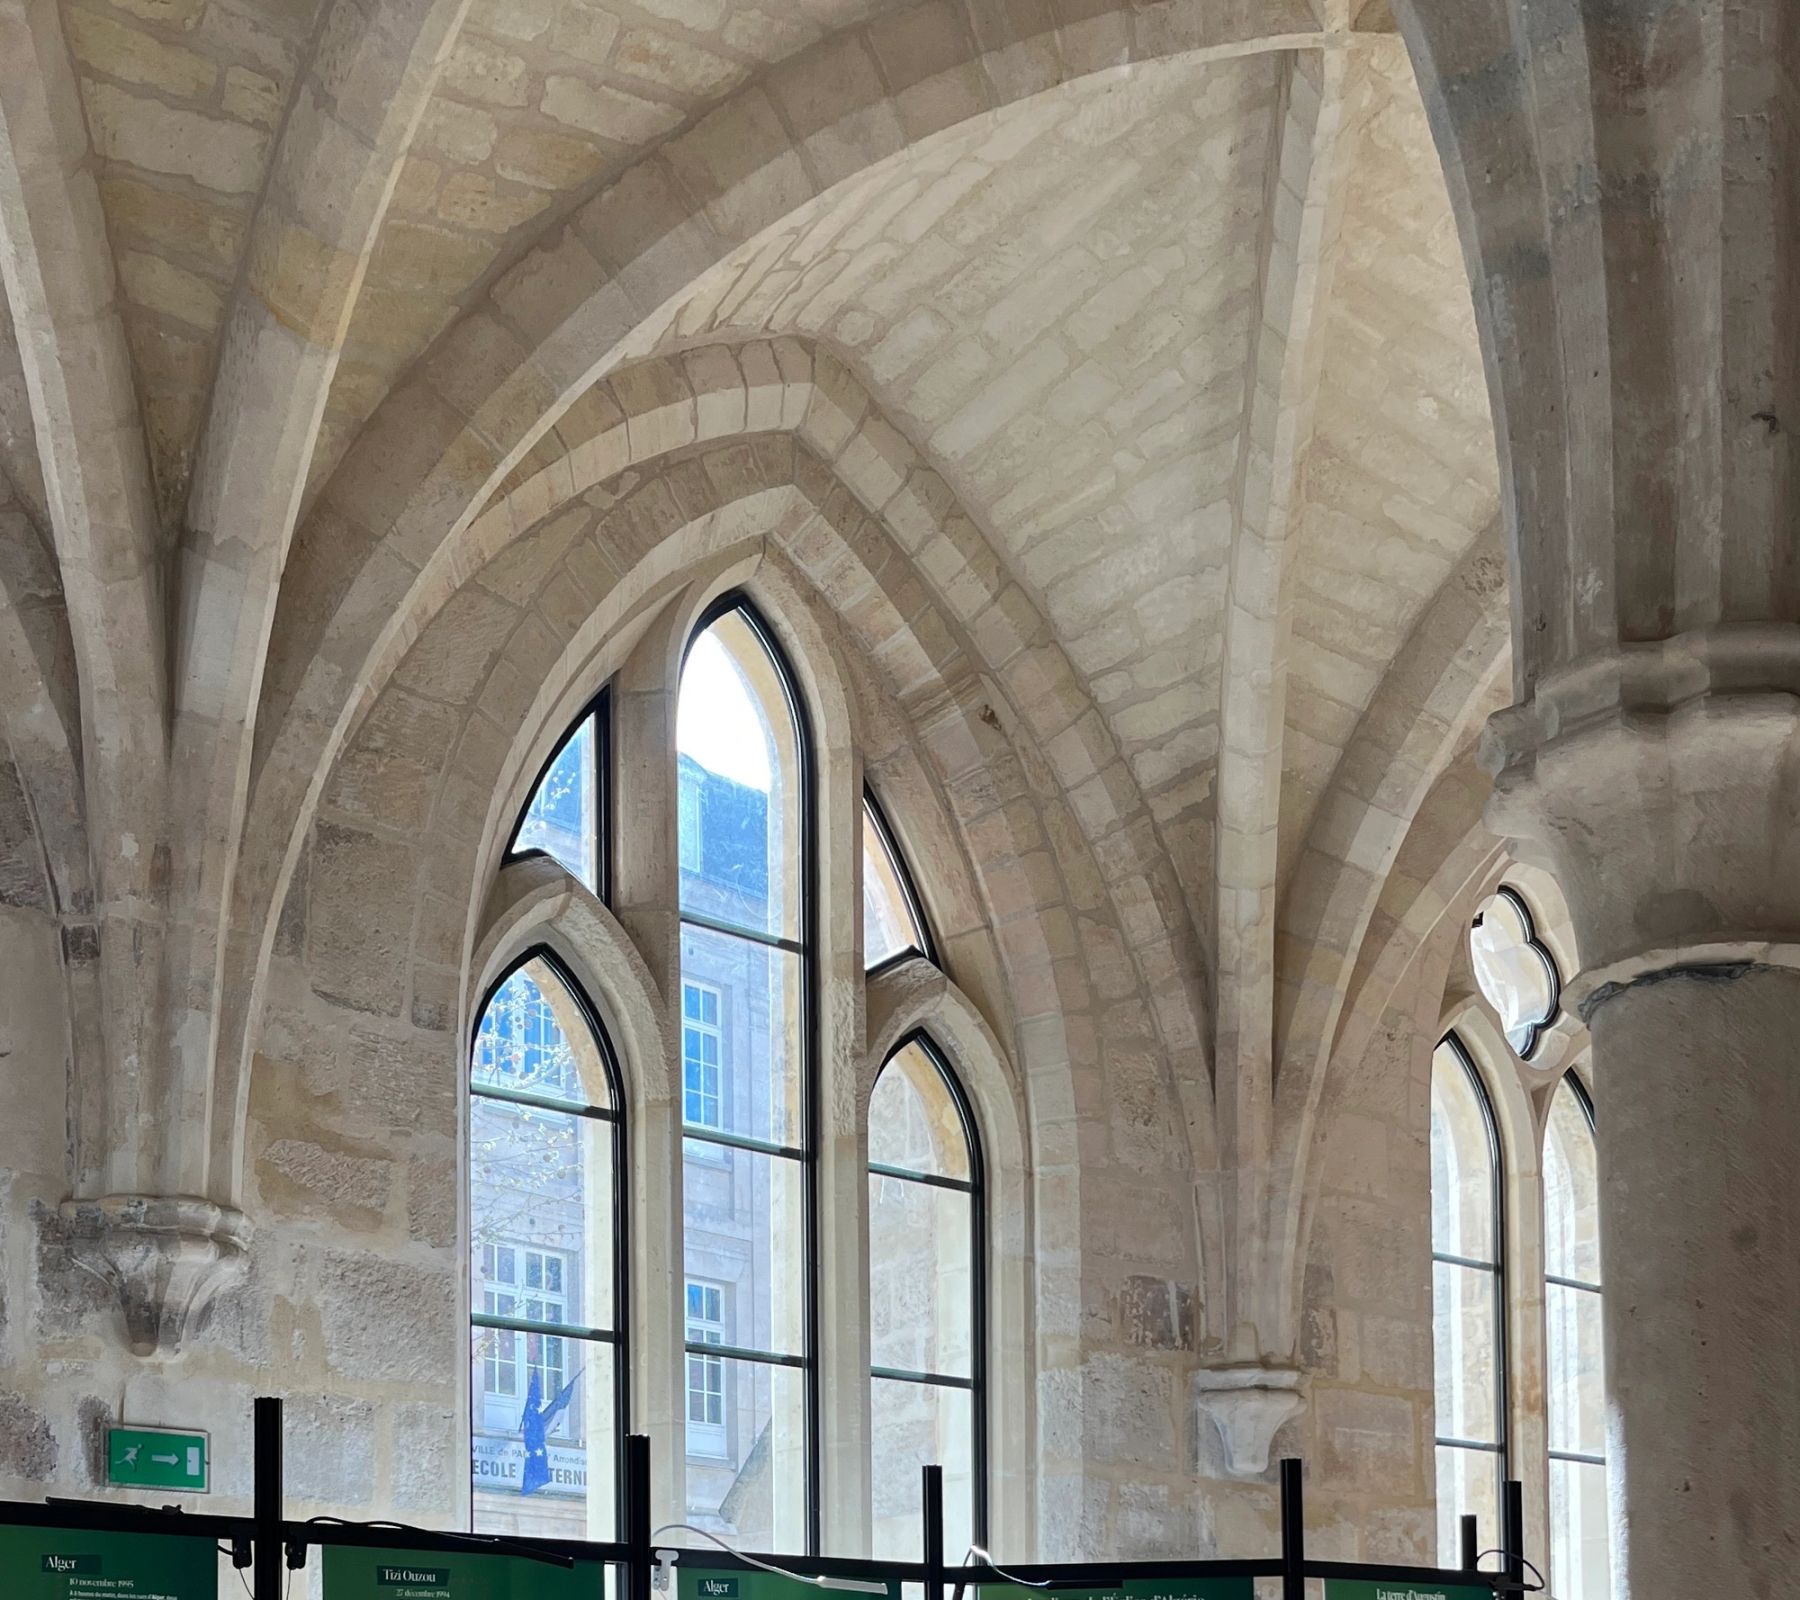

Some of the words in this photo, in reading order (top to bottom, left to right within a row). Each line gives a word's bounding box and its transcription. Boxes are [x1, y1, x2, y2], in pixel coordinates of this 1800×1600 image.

[472, 1459, 516, 1478] ECOLE
[45, 1556, 77, 1572] Alger
[383, 1569, 402, 1581] Tizi
[402, 1570, 437, 1582] Ouzou
[704, 1580, 730, 1596] Alger
[1376, 1588, 1386, 1600] La
